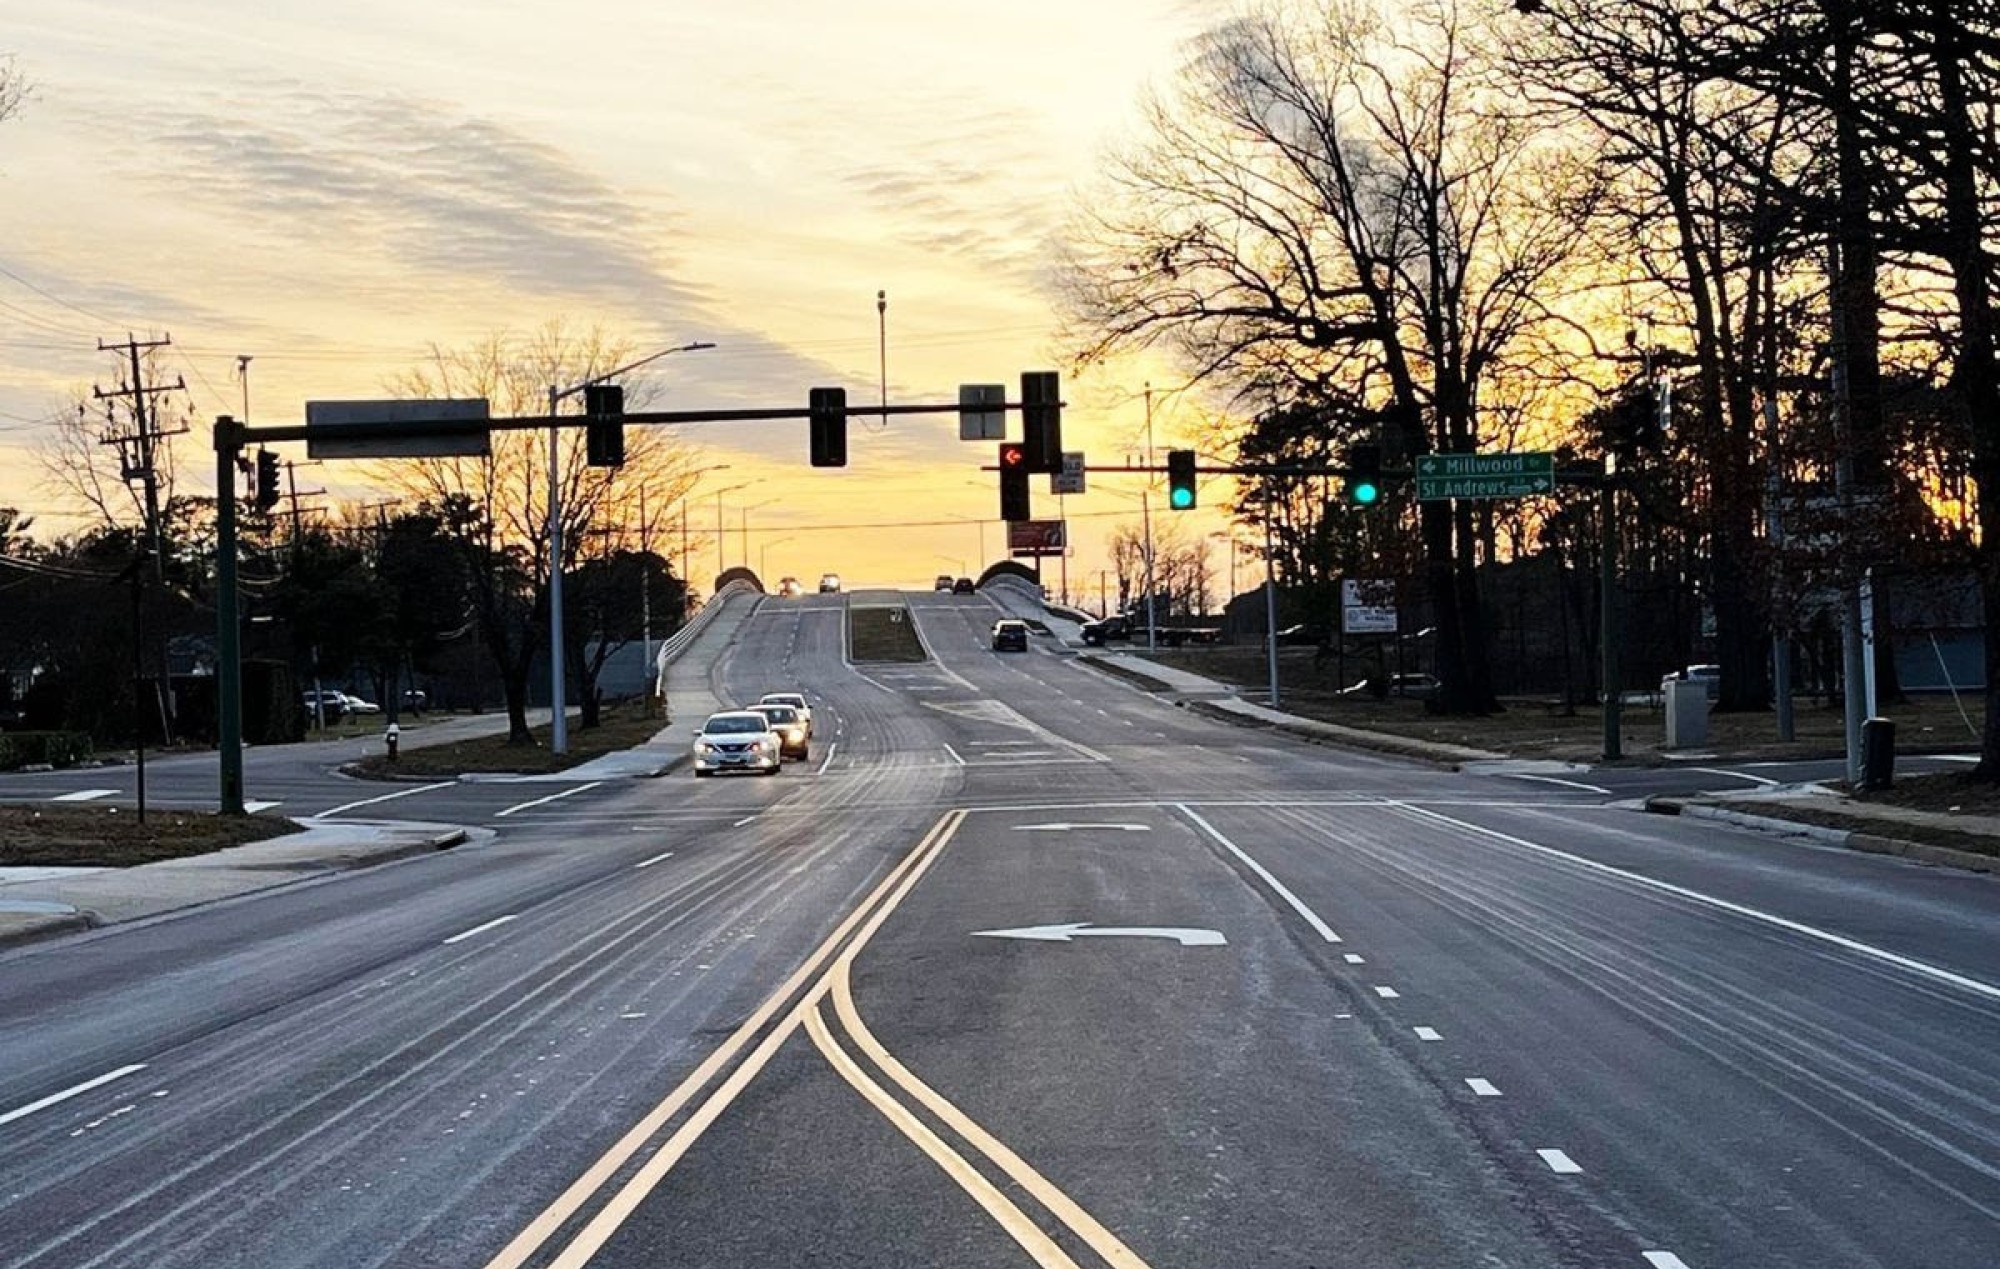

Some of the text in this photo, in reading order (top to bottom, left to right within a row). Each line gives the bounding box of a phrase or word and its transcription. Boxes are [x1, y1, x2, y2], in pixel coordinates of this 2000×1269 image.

[1446, 457, 1523, 473] Millwood
[1422, 483, 1436, 497] St
[1444, 480, 1506, 496] Andrews
